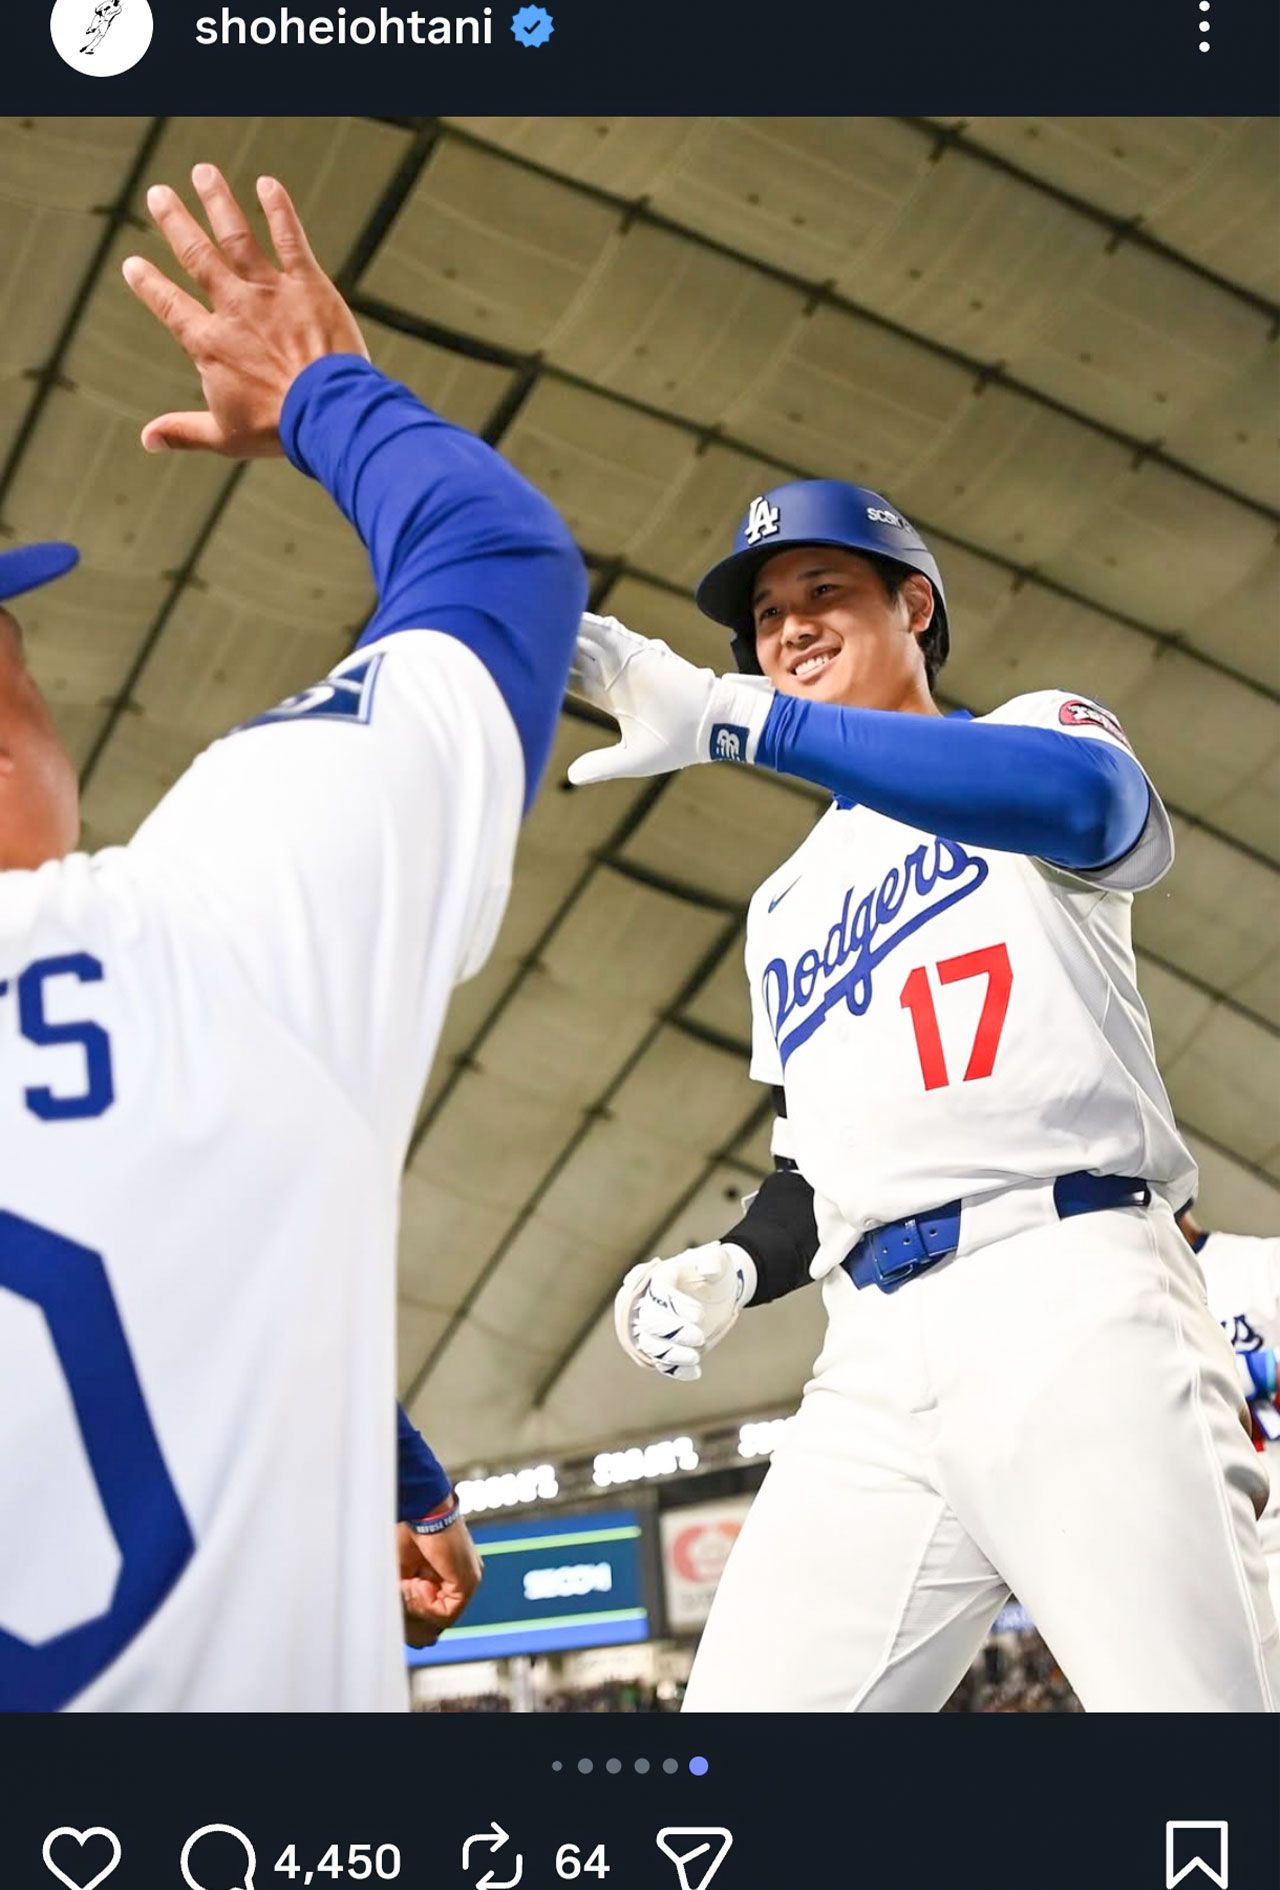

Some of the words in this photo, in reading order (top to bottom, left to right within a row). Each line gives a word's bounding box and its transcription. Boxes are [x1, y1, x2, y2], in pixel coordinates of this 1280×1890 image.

[744, 496, 779, 545] LA
[762, 837, 988, 1064] Dodgers
[900, 943, 1014, 1091] 17
